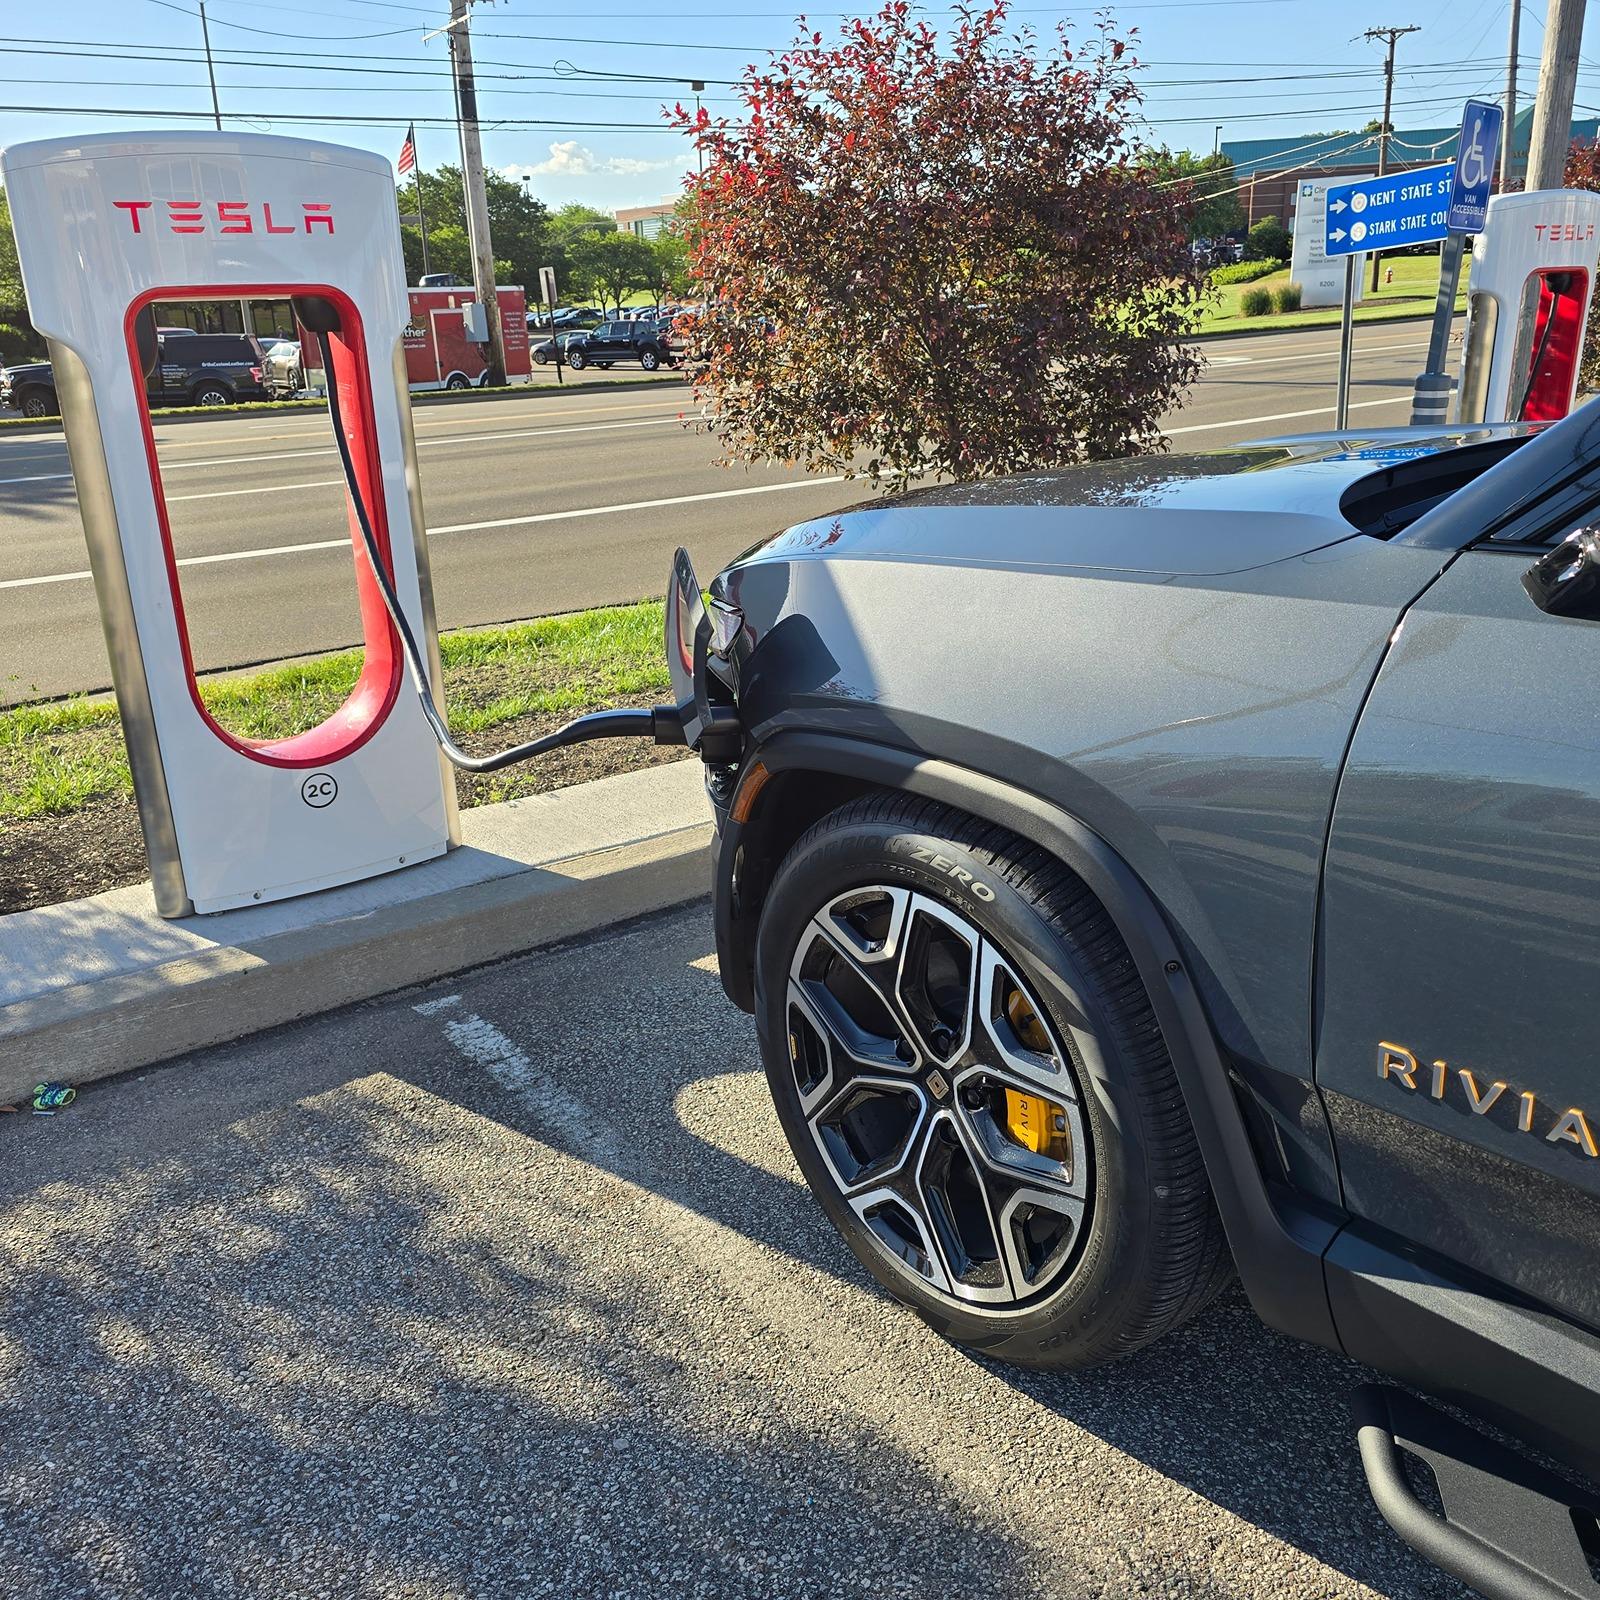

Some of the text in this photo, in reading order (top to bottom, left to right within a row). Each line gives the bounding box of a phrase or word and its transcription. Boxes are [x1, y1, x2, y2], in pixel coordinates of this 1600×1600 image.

[1370, 190, 1396, 207] KENT
[1400, 183, 1433, 201] STATE
[1464, 193, 1477, 204] VAN
[112, 201, 335, 234] TESLA
[1452, 204, 1485, 216] ACCESSIBLE
[1369, 219, 1397, 236] STARK
[1400, 214, 1427, 231] STATE
[1534, 224, 1594, 241] TESLA
[308, 782, 332, 798] 2C
[909, 846, 996, 903] ZERO
[1377, 1040, 1598, 1157] RIVIA
